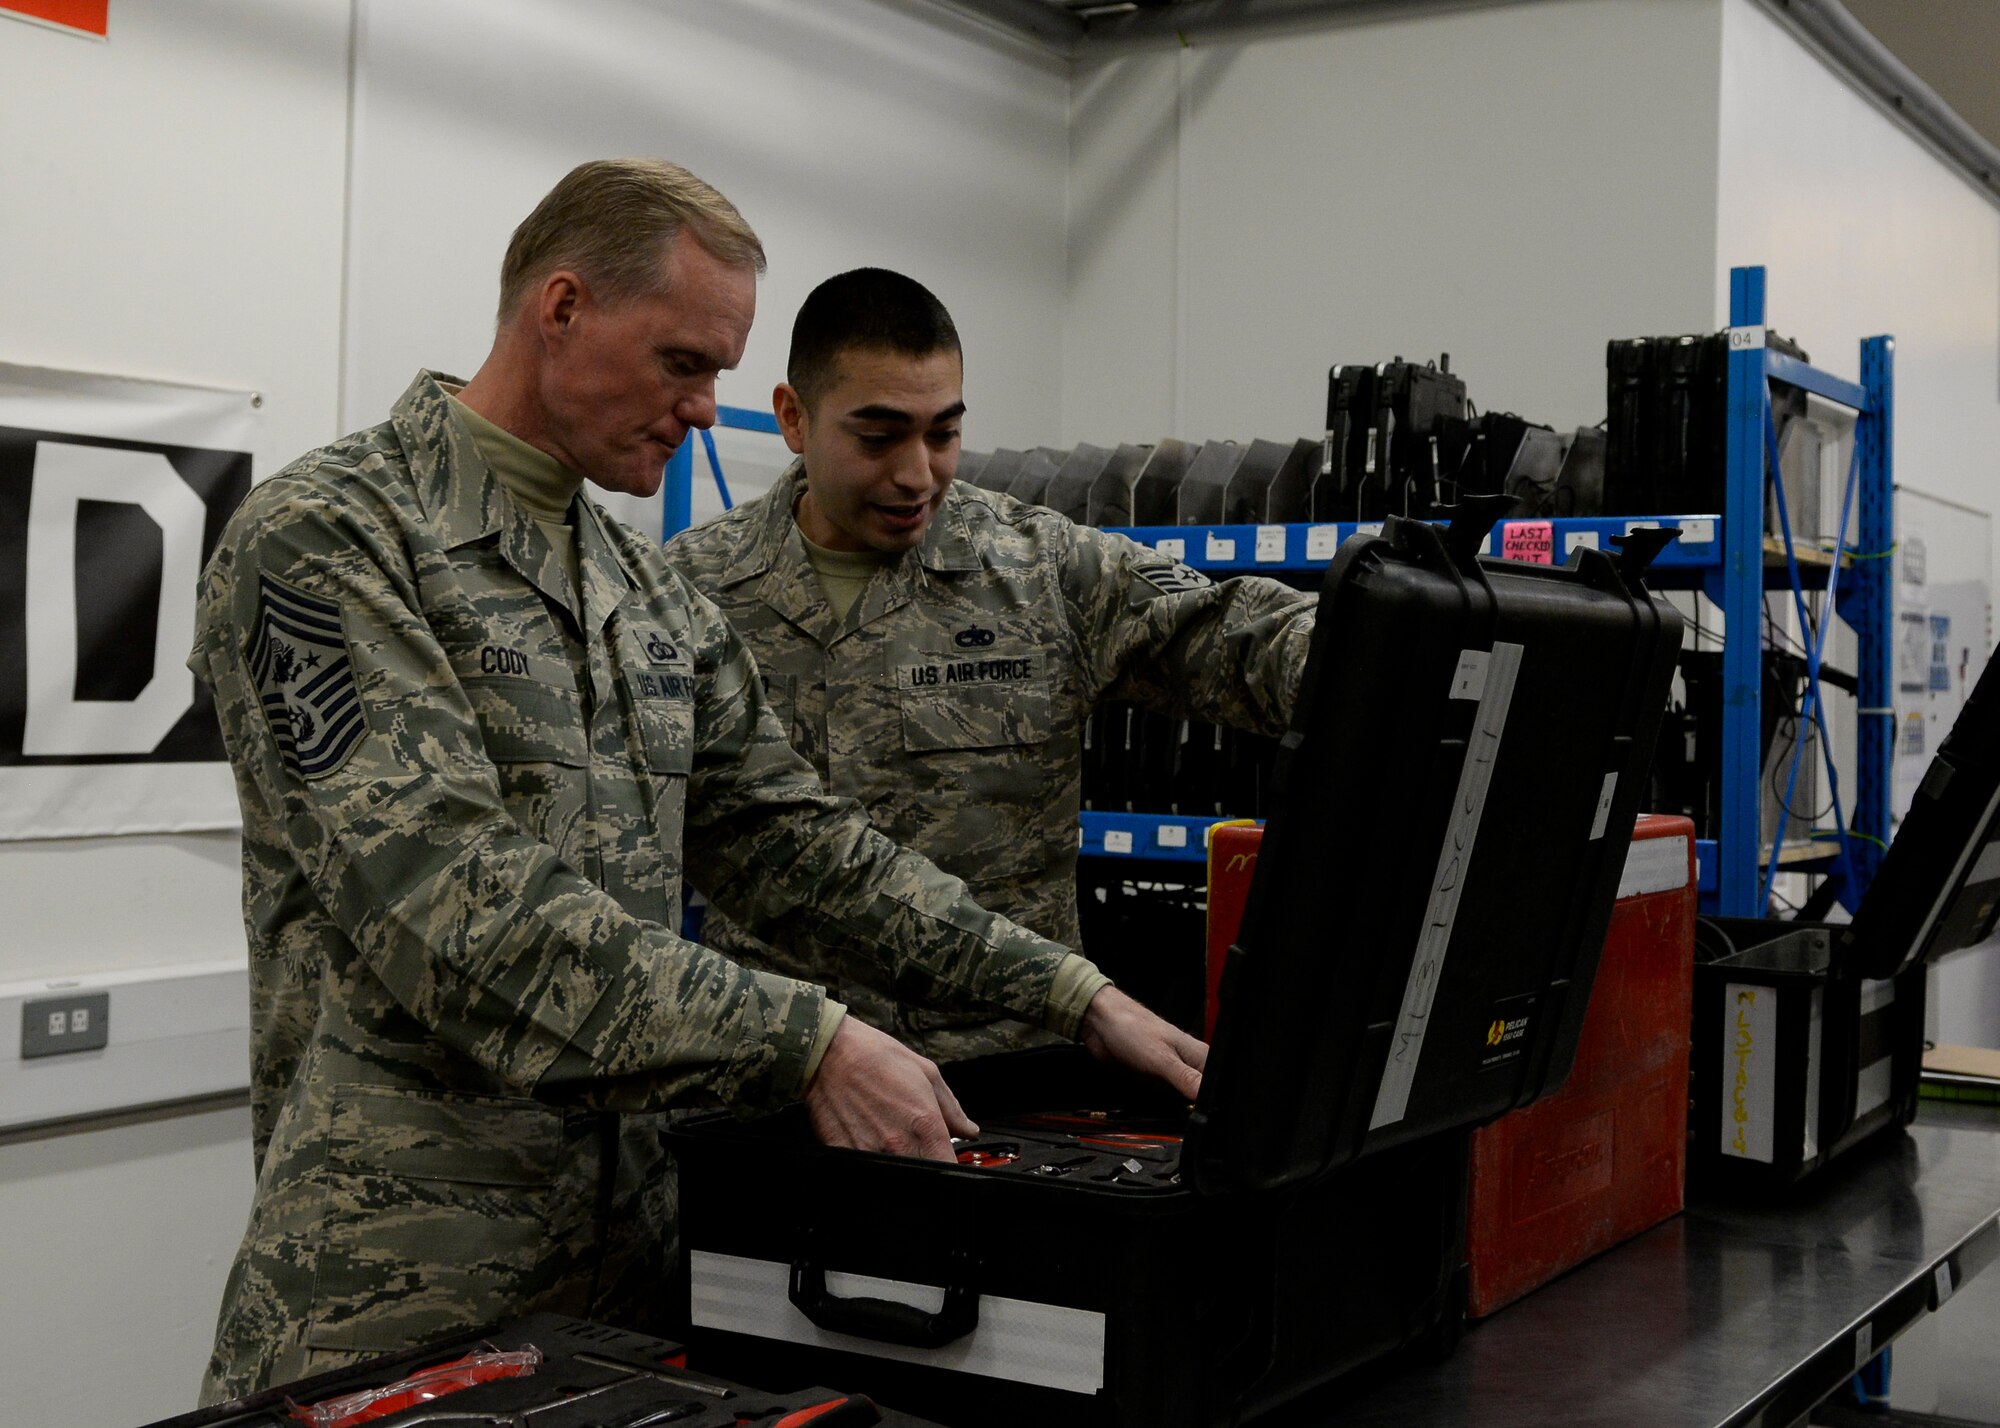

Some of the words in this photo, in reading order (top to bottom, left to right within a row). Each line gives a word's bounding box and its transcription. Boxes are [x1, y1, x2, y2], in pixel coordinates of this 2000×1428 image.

[1733, 331, 1751, 346] 04
[1510, 527, 1547, 539] LAST
[1505, 540, 1551, 552] CHECKED
[22, 440, 208, 757] D
[481, 645, 531, 676] CODY
[945, 663, 975, 684] AIR
[978, 659, 1032, 681] FORCE
[659, 675, 685, 698] AIR
